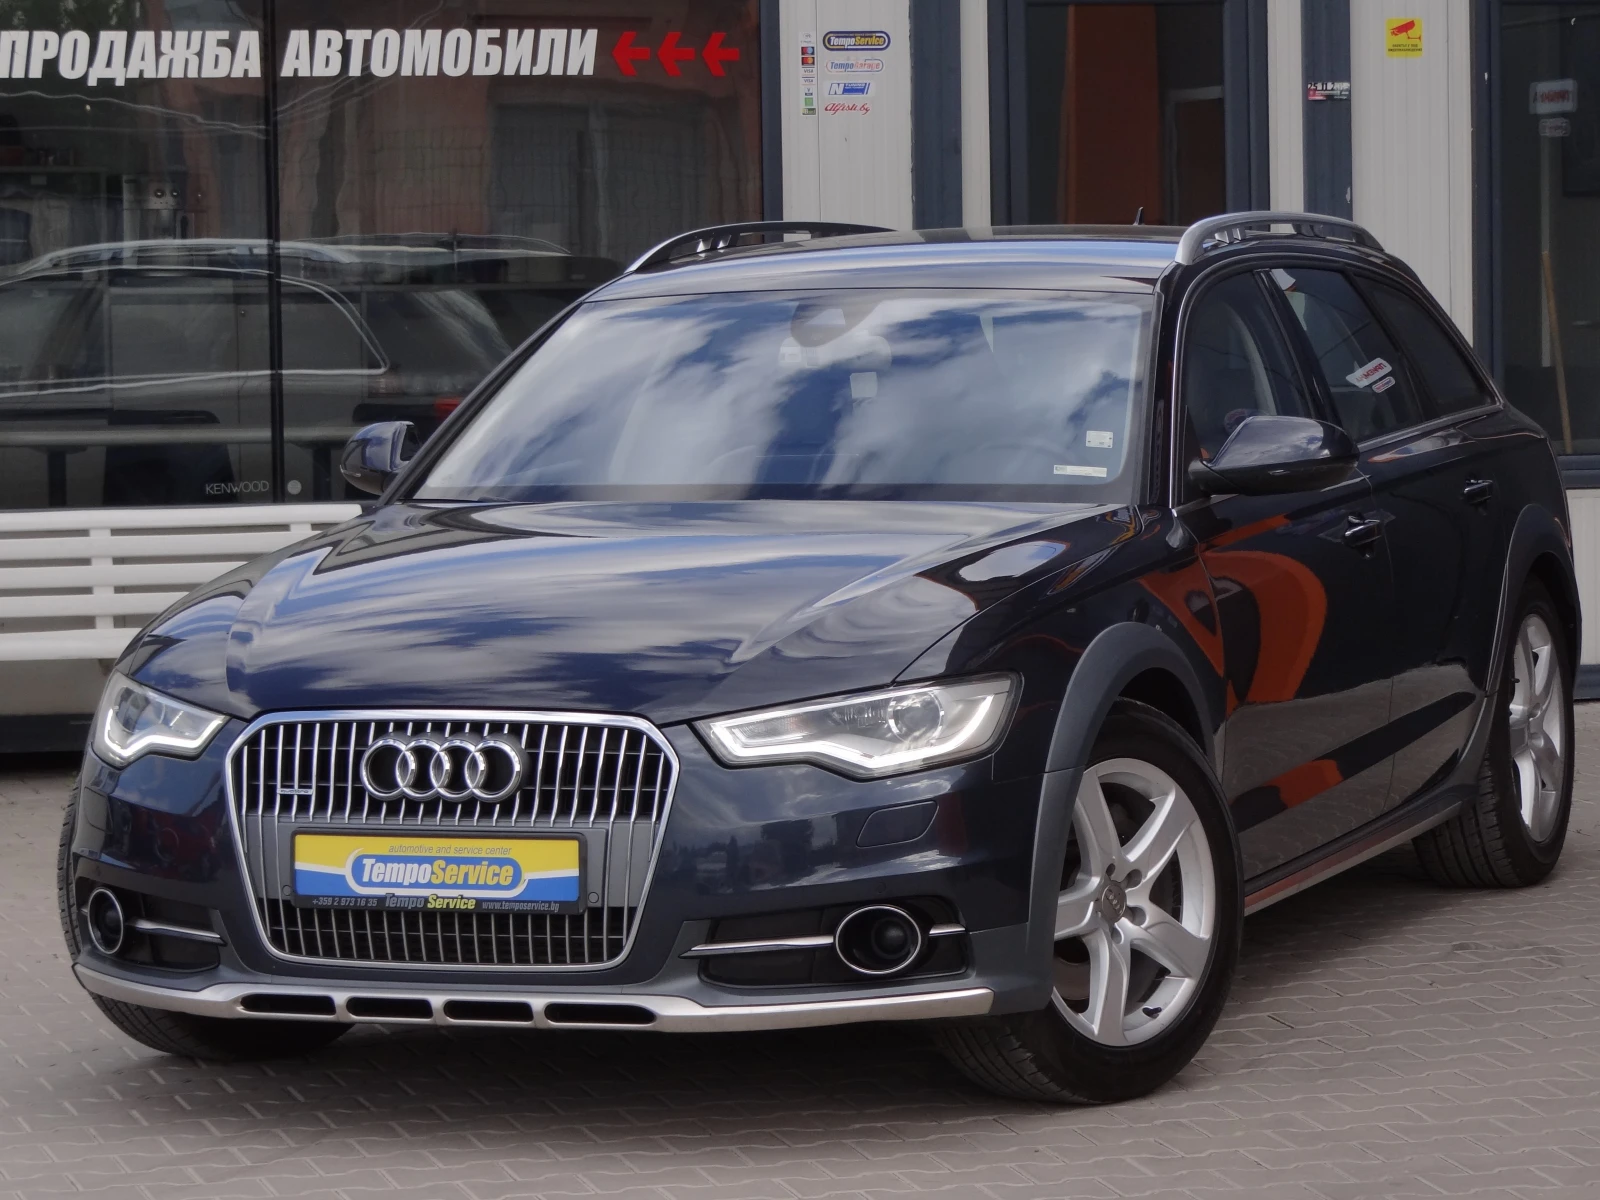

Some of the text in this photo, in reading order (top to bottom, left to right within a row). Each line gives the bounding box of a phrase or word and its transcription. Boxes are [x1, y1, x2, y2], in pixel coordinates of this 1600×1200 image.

[830, 35, 884, 48] TempoService
[0, 28, 598, 86] ПРОДАЖБА АВТОМОБИЛИ
[205, 480, 270, 495] KENWOOD
[388, 844, 512, 855] automotive and service center
[362, 858, 514, 886] TempoService
[312, 897, 333, 906] +359
[333, 897, 340, 906] 2
[341, 897, 355, 906] 973
[367, 898, 378, 907] 35
[384, 893, 424, 909] Tempo
[427, 894, 476, 909] Service
[482, 901, 560, 912] www.temposervice.bg
